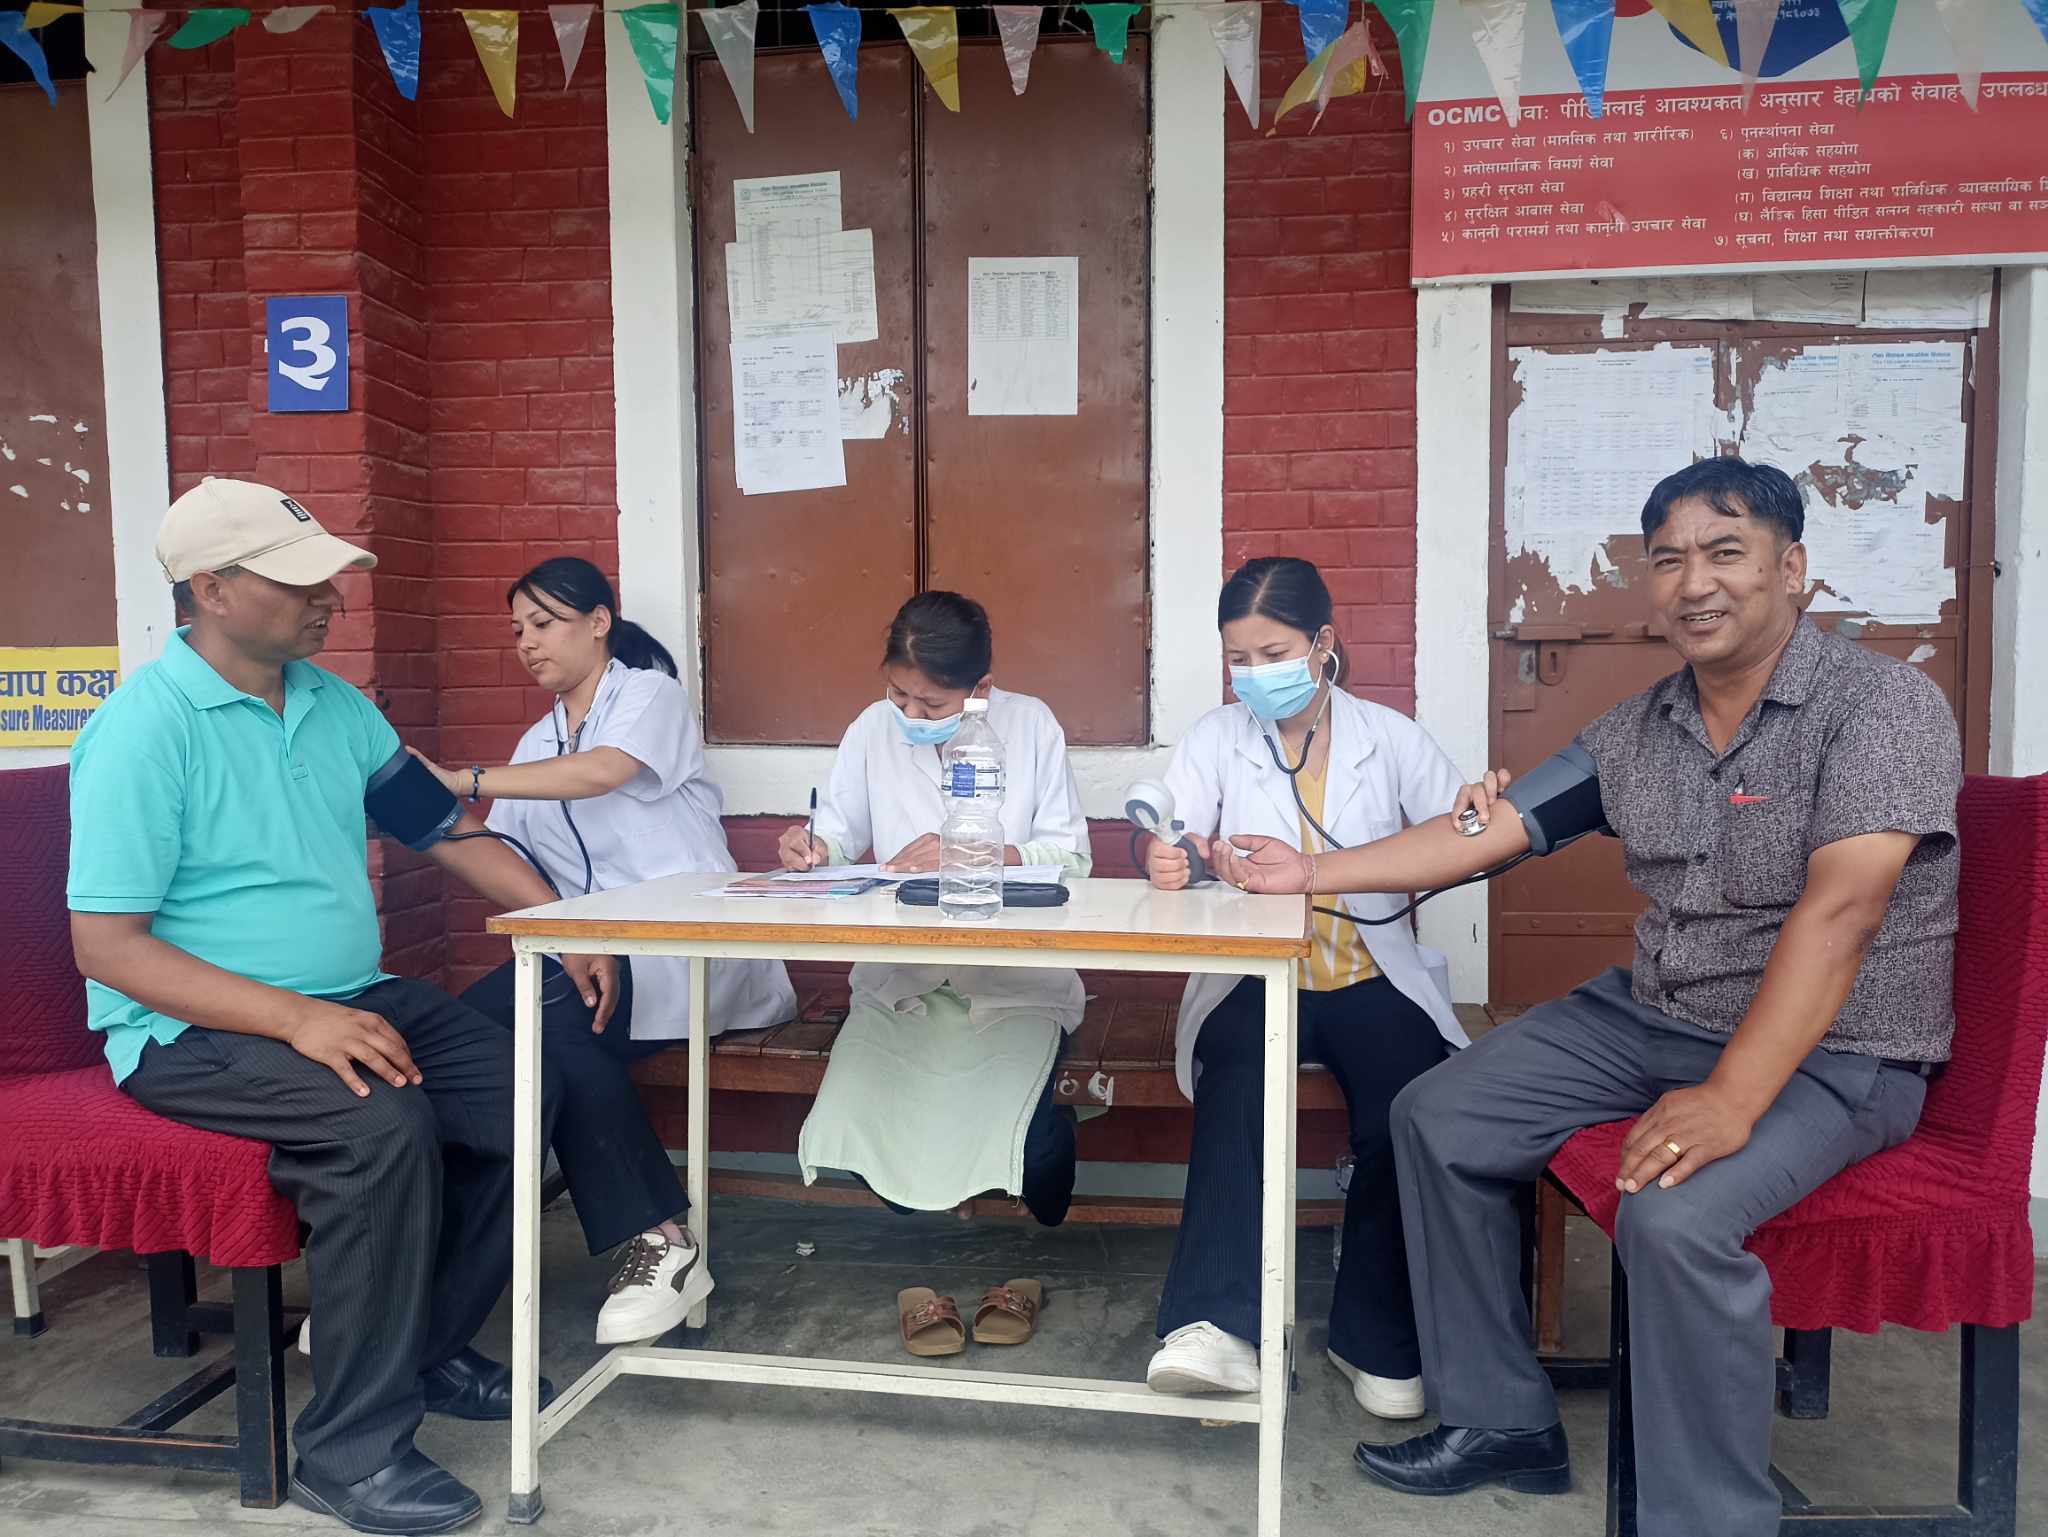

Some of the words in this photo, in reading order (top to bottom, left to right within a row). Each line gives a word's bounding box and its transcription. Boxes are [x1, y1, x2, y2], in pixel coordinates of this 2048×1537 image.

[1427, 104, 1501, 126] OCMC
[1759, 90, 1824, 114] अनुसार
[1443, 141, 1455, 153] १)
[1463, 138, 1505, 152] उपचार
[1511, 133, 1536, 148] सेवा
[1542, 130, 1596, 147] (मानसिक
[1603, 131, 1627, 144] तथा
[1632, 125, 1694, 143] शारीरिक)
[1808, 121, 1835, 136] सेवा
[1738, 148, 1759, 161] (क)
[1766, 142, 1809, 159] आर्थिक
[1815, 141, 1858, 158] सहयोग
[1444, 165, 1456, 177] २)
[1463, 158, 1542, 176] मनोसामाजिक
[1589, 154, 1615, 169] सेवा
[1737, 168, 1759, 180] (ख)
[1828, 160, 1872, 177] सहयोग
[1462, 182, 1492, 199] प्रहरी
[1498, 183, 1534, 201] सुरक्षा
[1540, 179, 1565, 193] सेवा
[1735, 192, 1754, 204] (ग)
[1762, 187, 1813, 203] विद्यालय
[1819, 184, 1854, 201] शिक्षा
[1859, 186, 1884, 199] तथा
[1464, 203, 1509, 225] सुरक्षित
[1514, 204, 1553, 217] आवास
[1559, 200, 1585, 215] सेवा
[1555, 223, 1579, 235] तथा
[1631, 219, 1675, 232] उपचार
[1681, 215, 1707, 230] सेवा
[1783, 227, 1818, 244] शिक्षा
[1823, 230, 1848, 242] तथा
[56, 669, 118, 700] कक्ष
